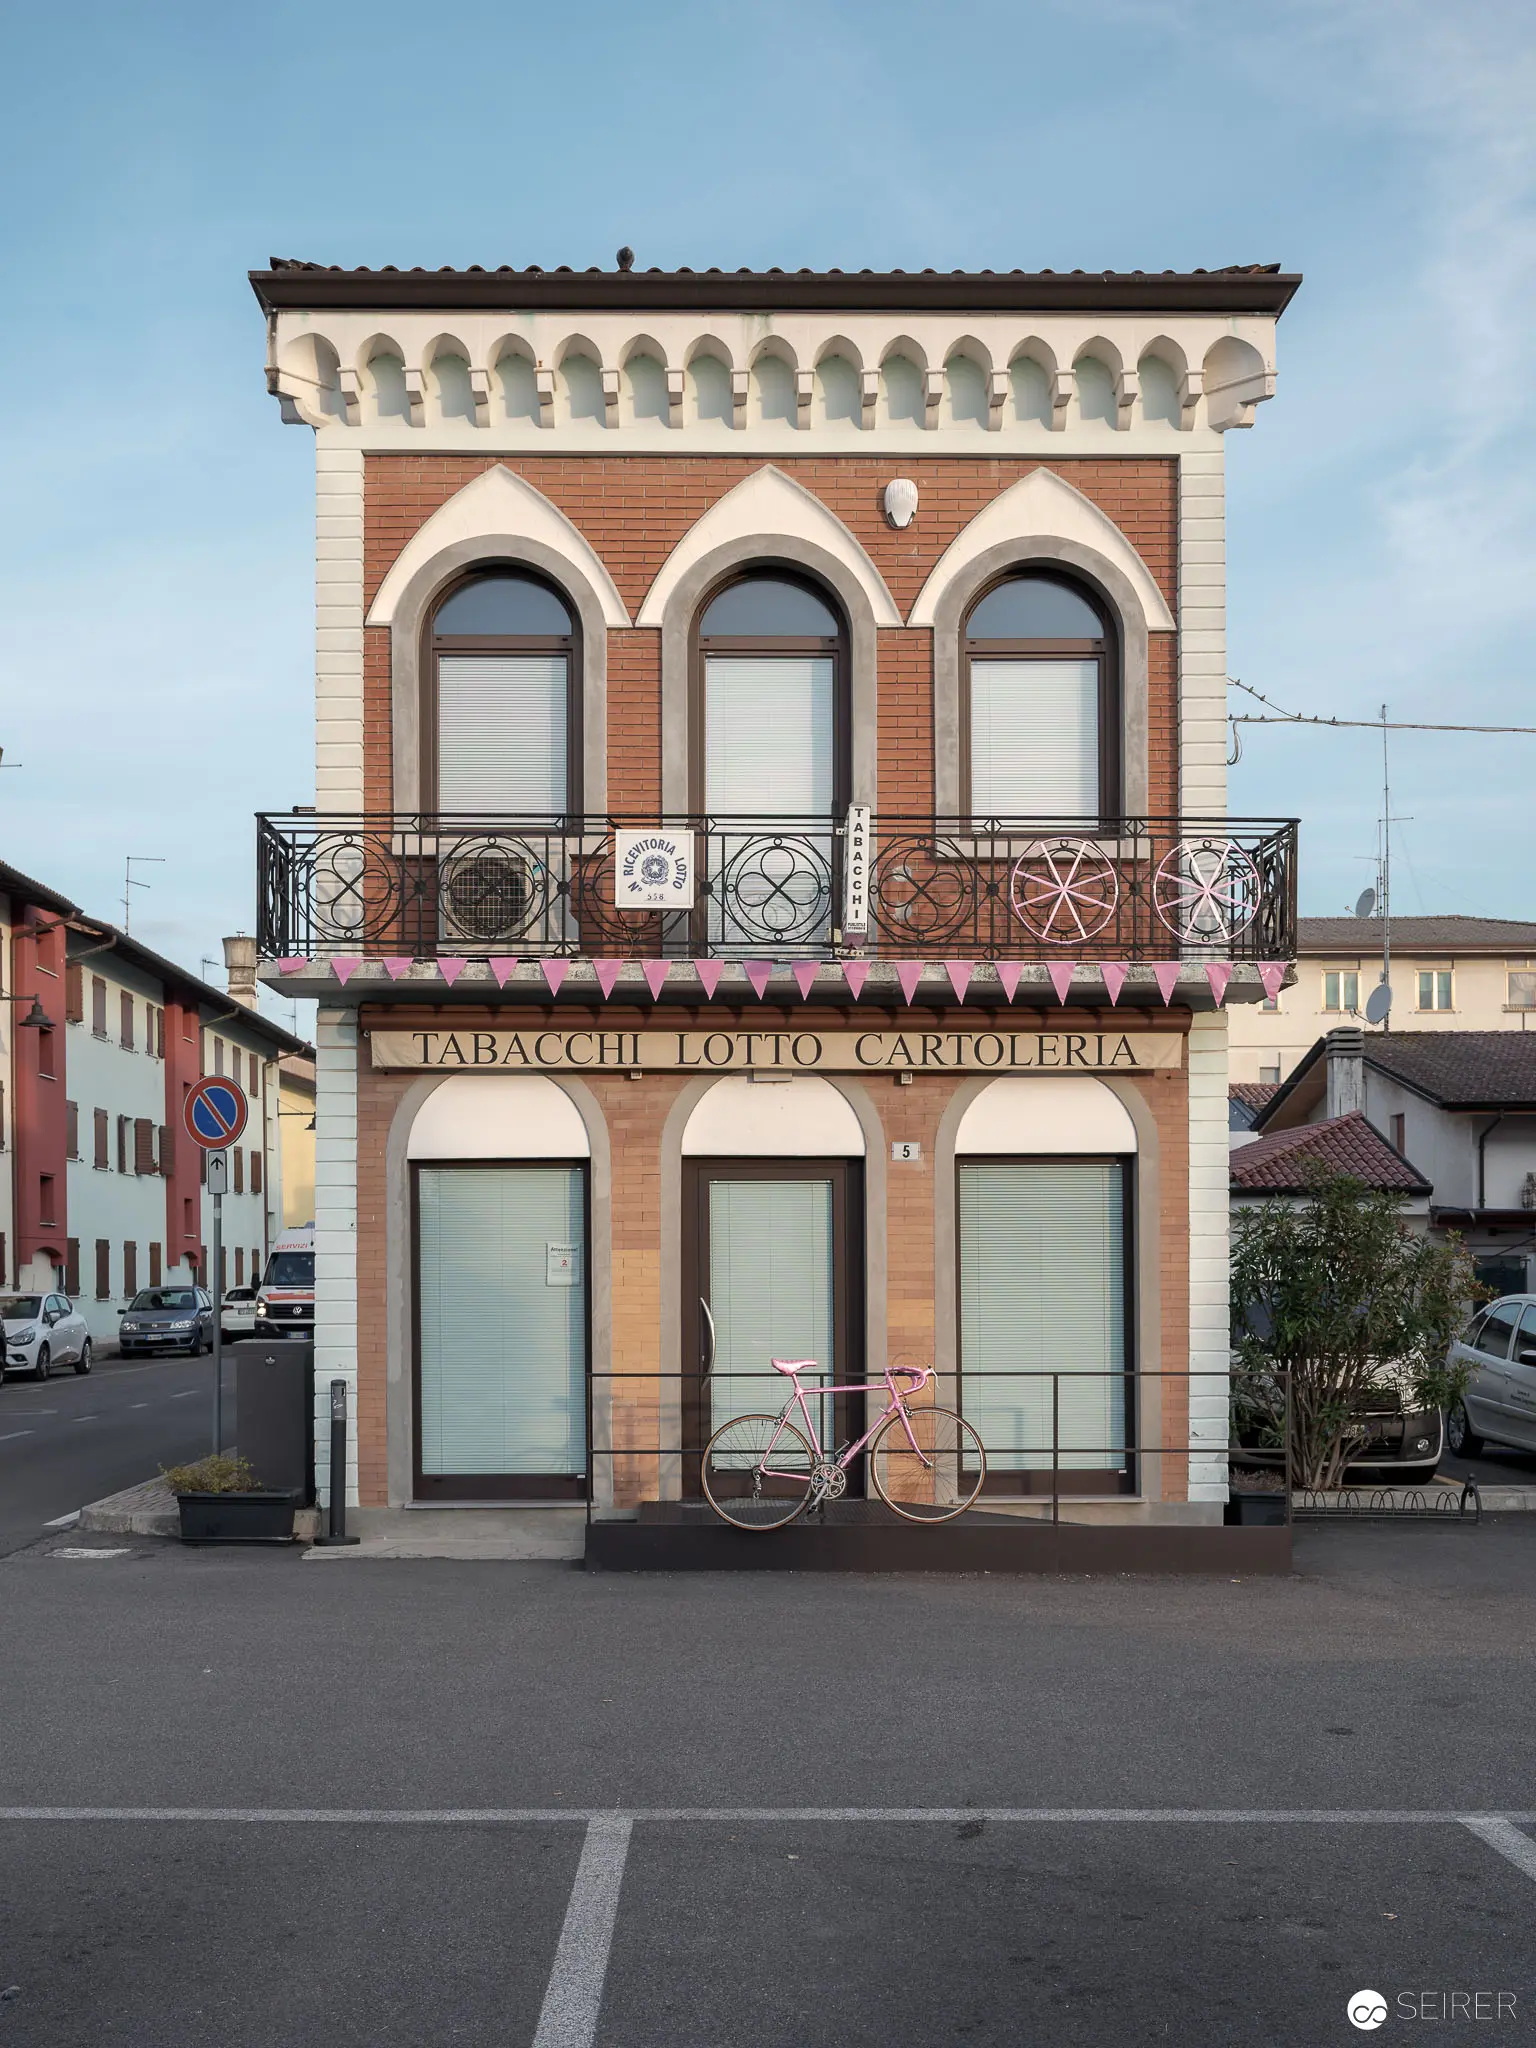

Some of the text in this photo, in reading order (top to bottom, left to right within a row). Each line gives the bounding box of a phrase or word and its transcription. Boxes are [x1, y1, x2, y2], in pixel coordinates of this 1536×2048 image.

[623, 838, 687, 890] RICEVITORIA LOTTO
[852, 808, 864, 919] TABACCHI
[412, 1033, 1141, 1066] TABACCHI LOTTO CARTOLERIA
[902, 1144, 910, 1158] 5
